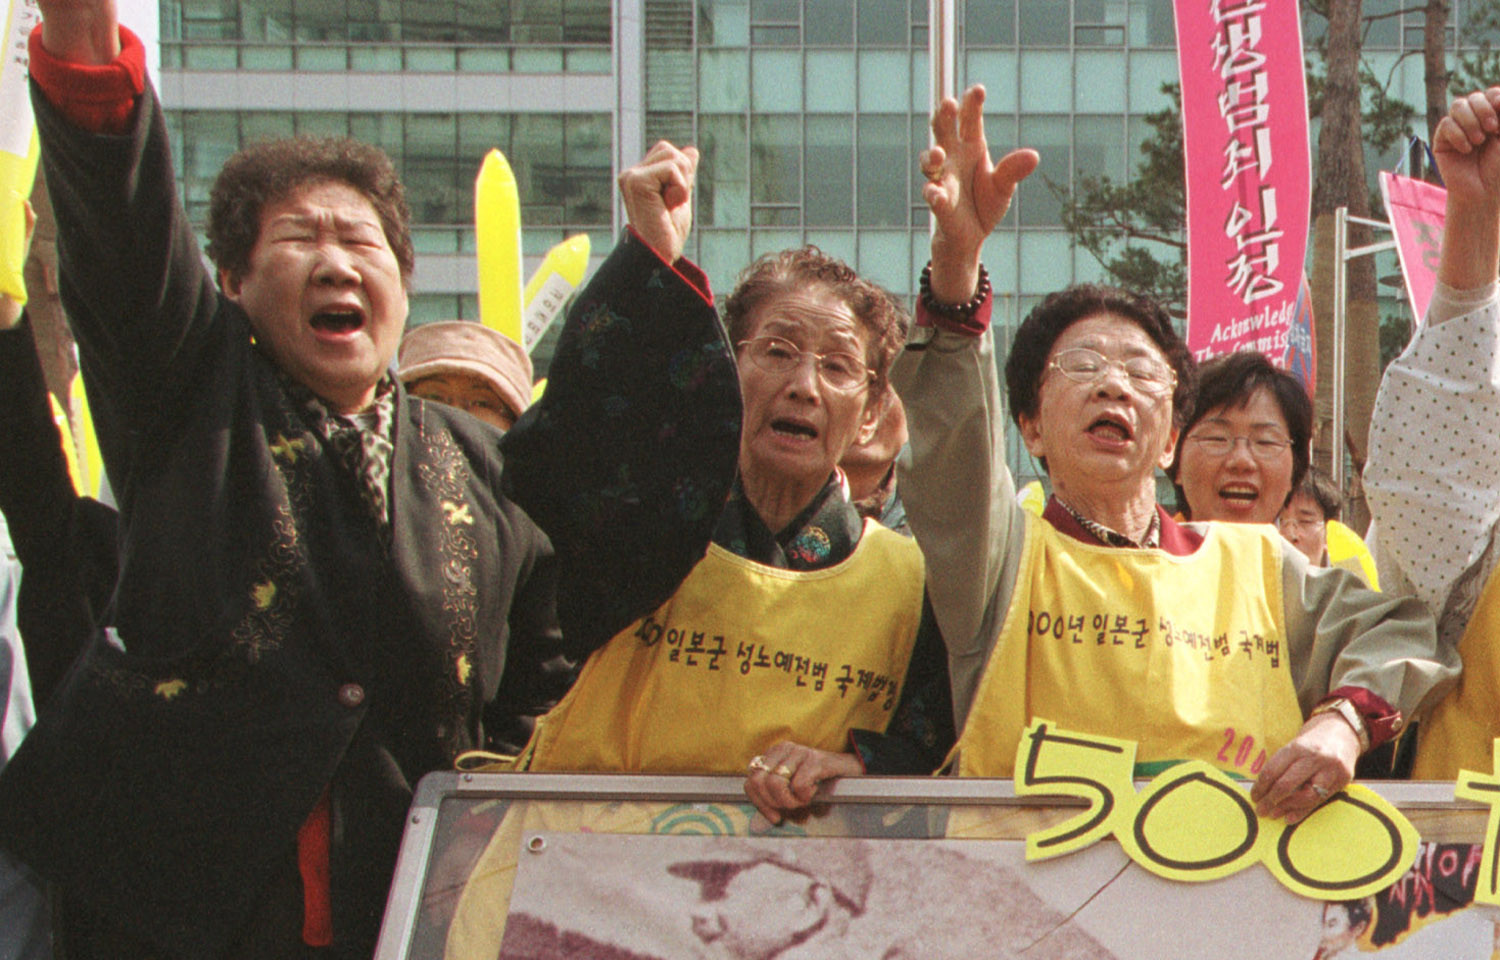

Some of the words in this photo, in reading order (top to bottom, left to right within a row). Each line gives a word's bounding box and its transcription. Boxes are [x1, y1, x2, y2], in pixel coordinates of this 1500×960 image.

[666, 628, 727, 671] 일본군
[736, 641, 829, 692] 성노예전범
[1092, 613, 1150, 649] 일본군
[1237, 630, 1281, 669] 국제법
